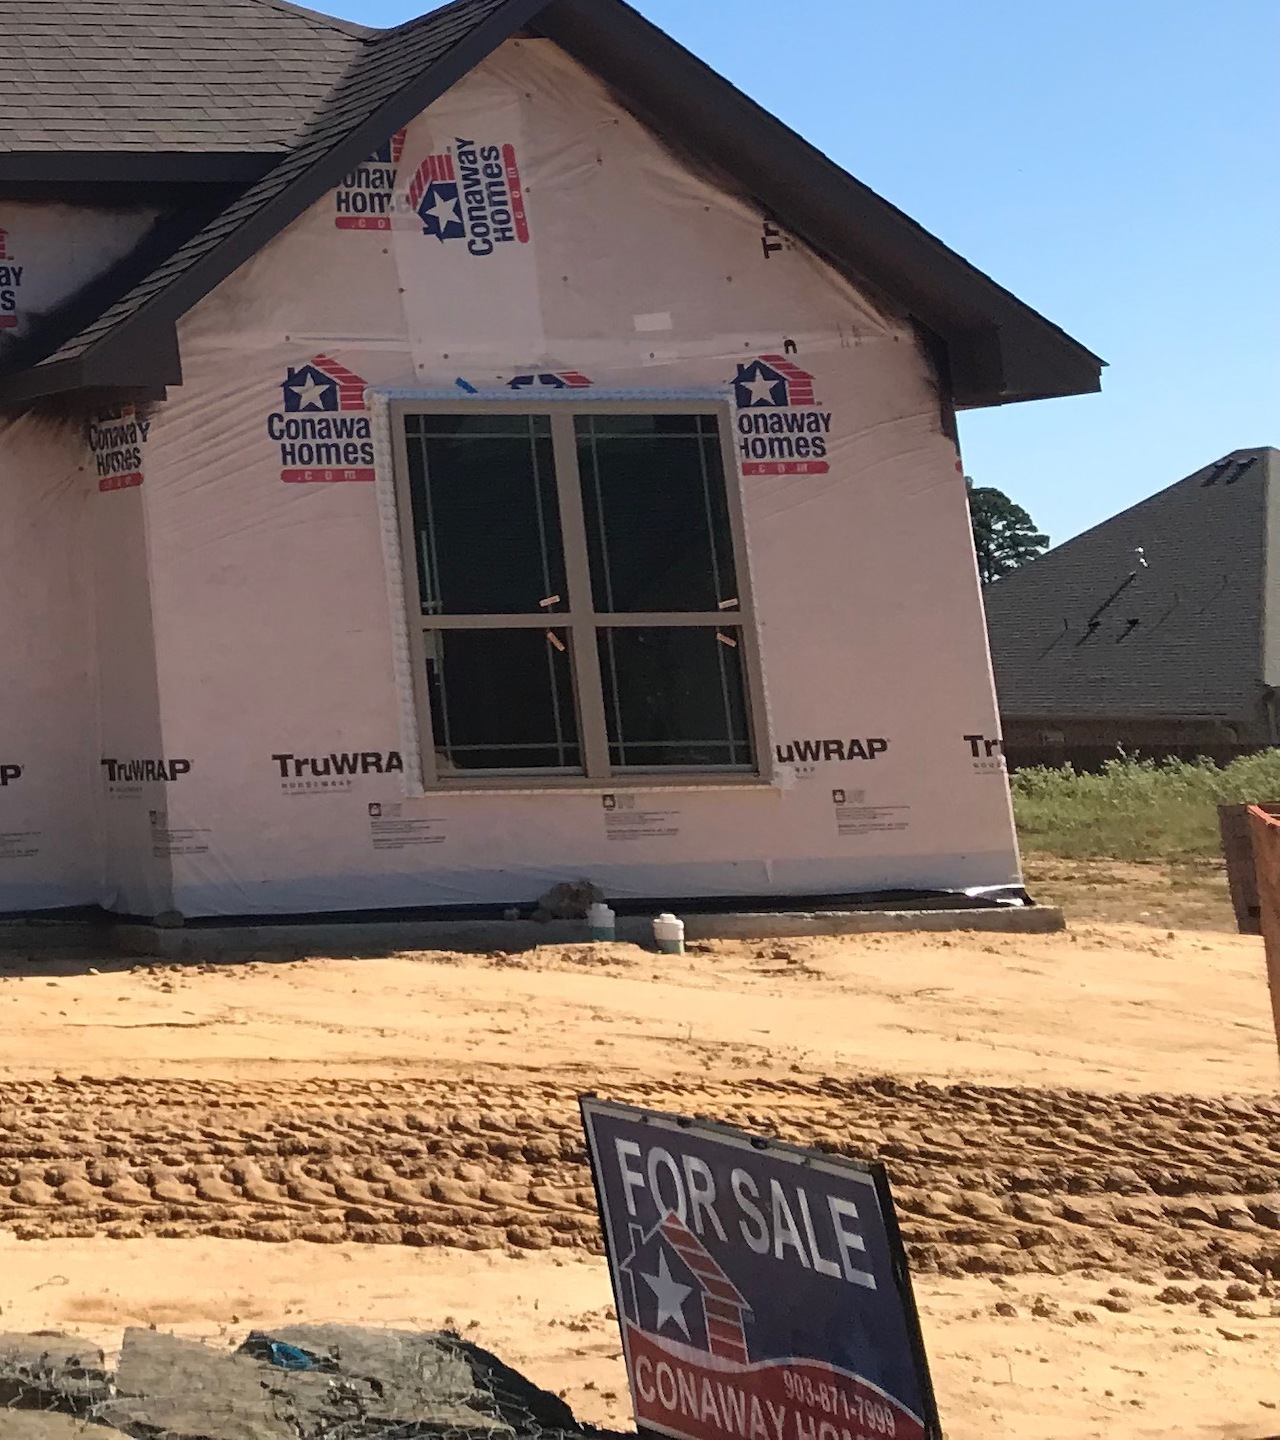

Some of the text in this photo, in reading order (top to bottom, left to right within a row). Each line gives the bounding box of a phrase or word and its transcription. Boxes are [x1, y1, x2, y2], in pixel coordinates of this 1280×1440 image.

[456, 137, 493, 257] Conaway
[480, 143, 515, 243] Homes
[280, 442, 375, 466] Homes
[738, 412, 832, 436] onaway
[100, 758, 191, 782] TruWRAP
[614, 1138, 877, 1290] FOR SALE
[635, 1355, 785, 1440] CONAWAY
[783, 1369, 896, 1438] 903-871-7999
